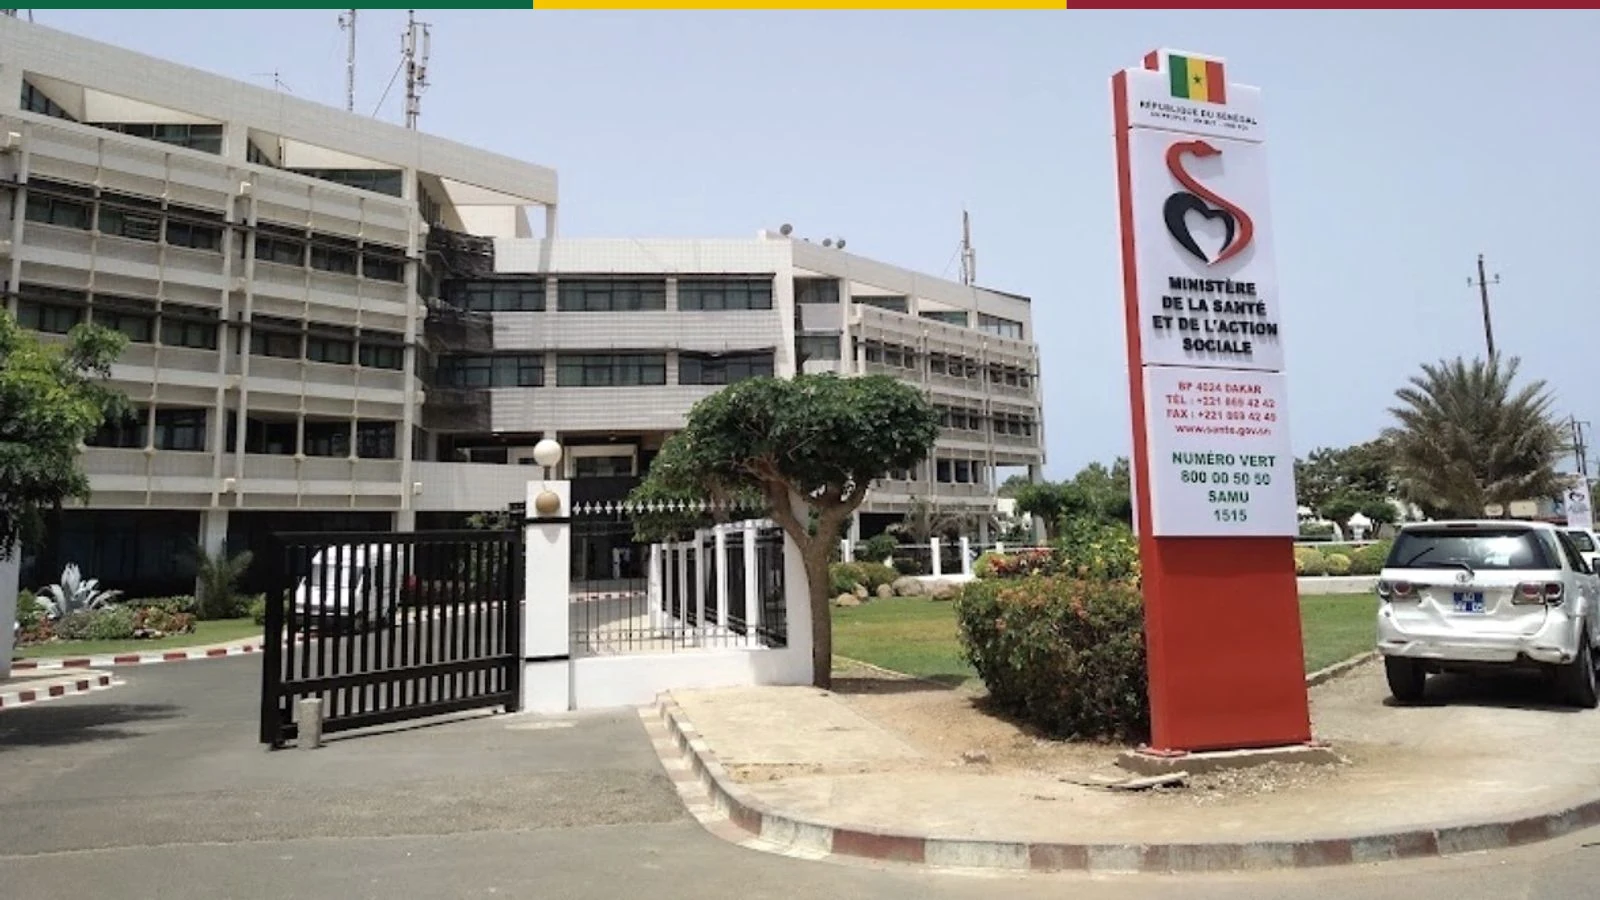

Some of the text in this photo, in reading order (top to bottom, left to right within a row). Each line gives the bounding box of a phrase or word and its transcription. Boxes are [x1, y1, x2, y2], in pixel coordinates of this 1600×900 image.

[1140, 100, 1258, 125] RÉPUBLIQUE DU SÉNÉGAL
[1168, 276, 1257, 295] MINISTÈRE
[1162, 295, 1267, 316] DE LA SANTÉ
[1152, 315, 1278, 335] ET DE L'ACTION
[1182, 338, 1253, 355] SOCIALE
[1178, 381, 1192, 391] BP
[1225, 384, 1262, 394] DAKAR
[1166, 408, 1188, 419] FAX
[1171, 449, 1276, 467] NUMÉRO VERT
[1181, 469, 1271, 485] 800 00 50 50
[1208, 490, 1249, 503] SAMU
[1214, 508, 1247, 522] 1515
